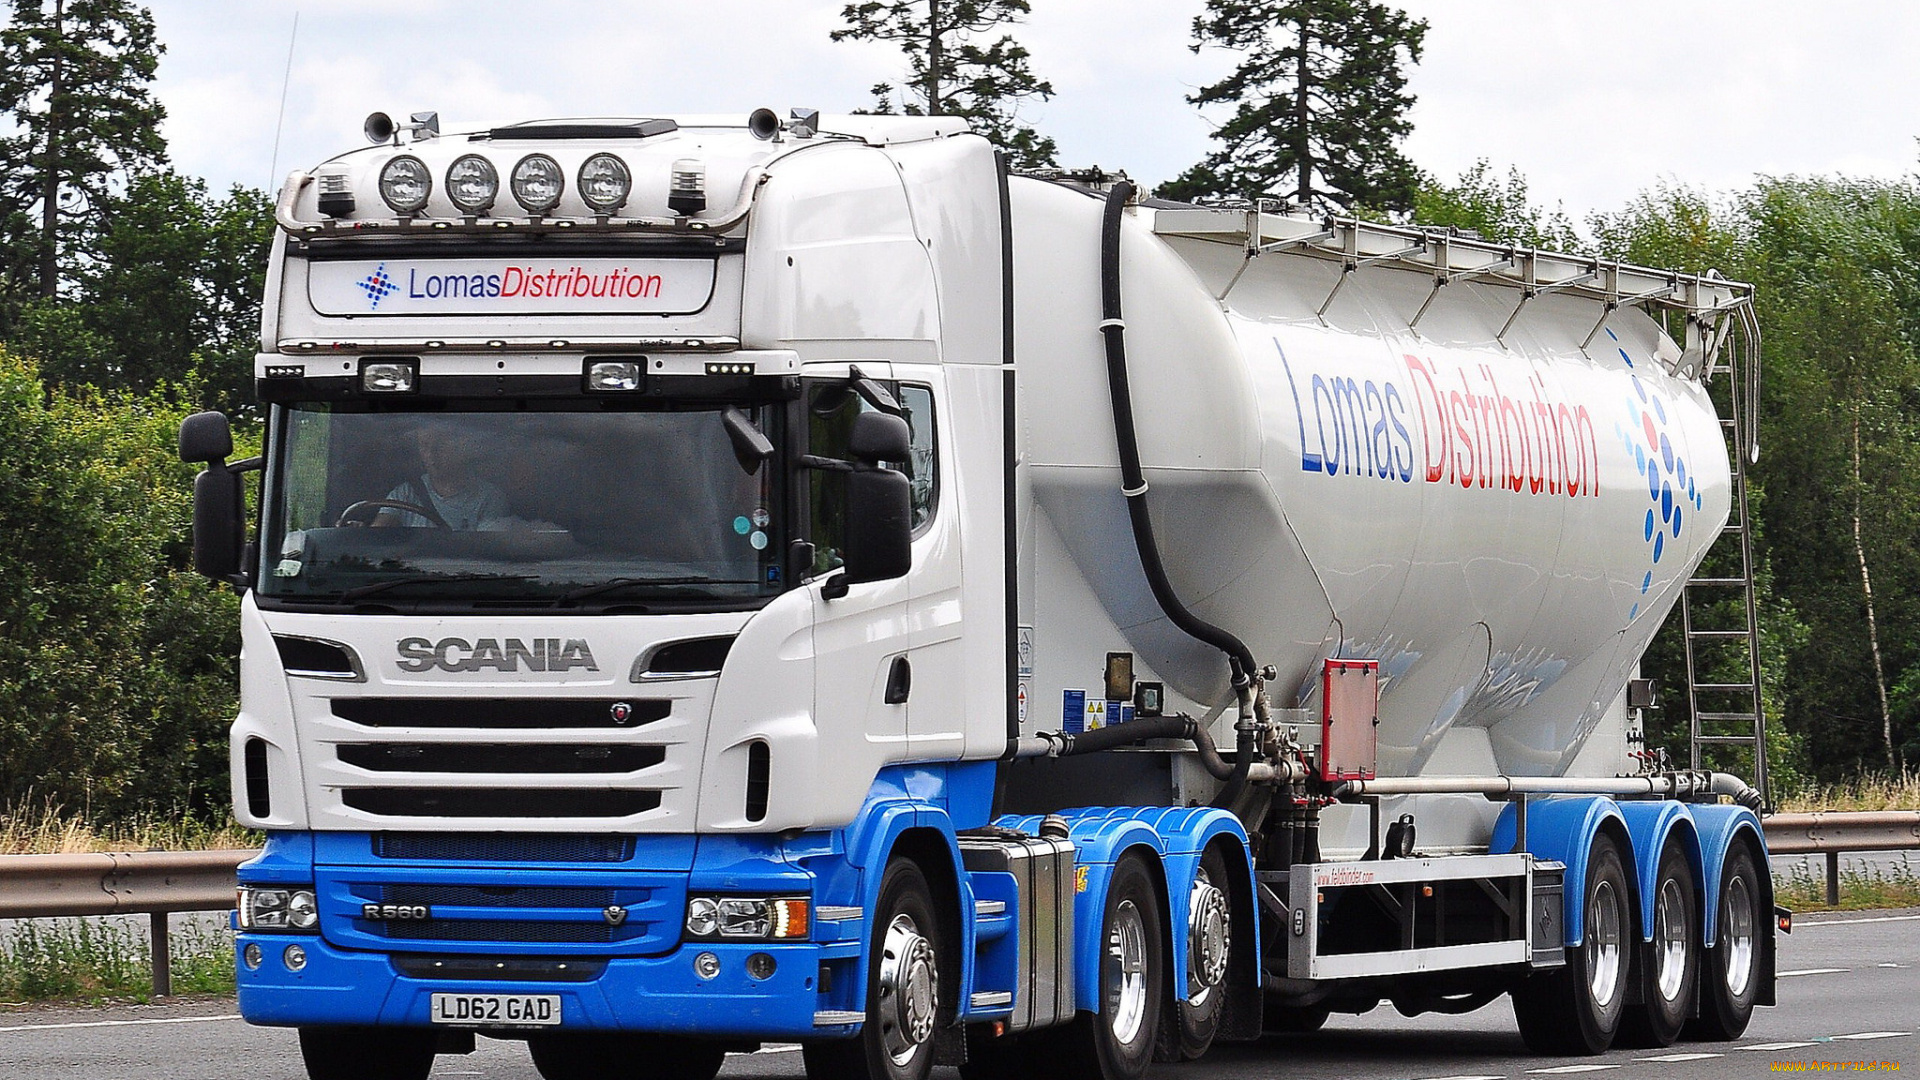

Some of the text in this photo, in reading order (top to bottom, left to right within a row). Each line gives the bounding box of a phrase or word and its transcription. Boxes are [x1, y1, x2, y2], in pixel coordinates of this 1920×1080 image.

[1273, 336, 1599, 498] Lomas Distribution
[396, 637, 600, 672] SCANIA
[441, 997, 551, 1020] LD62 GAD
